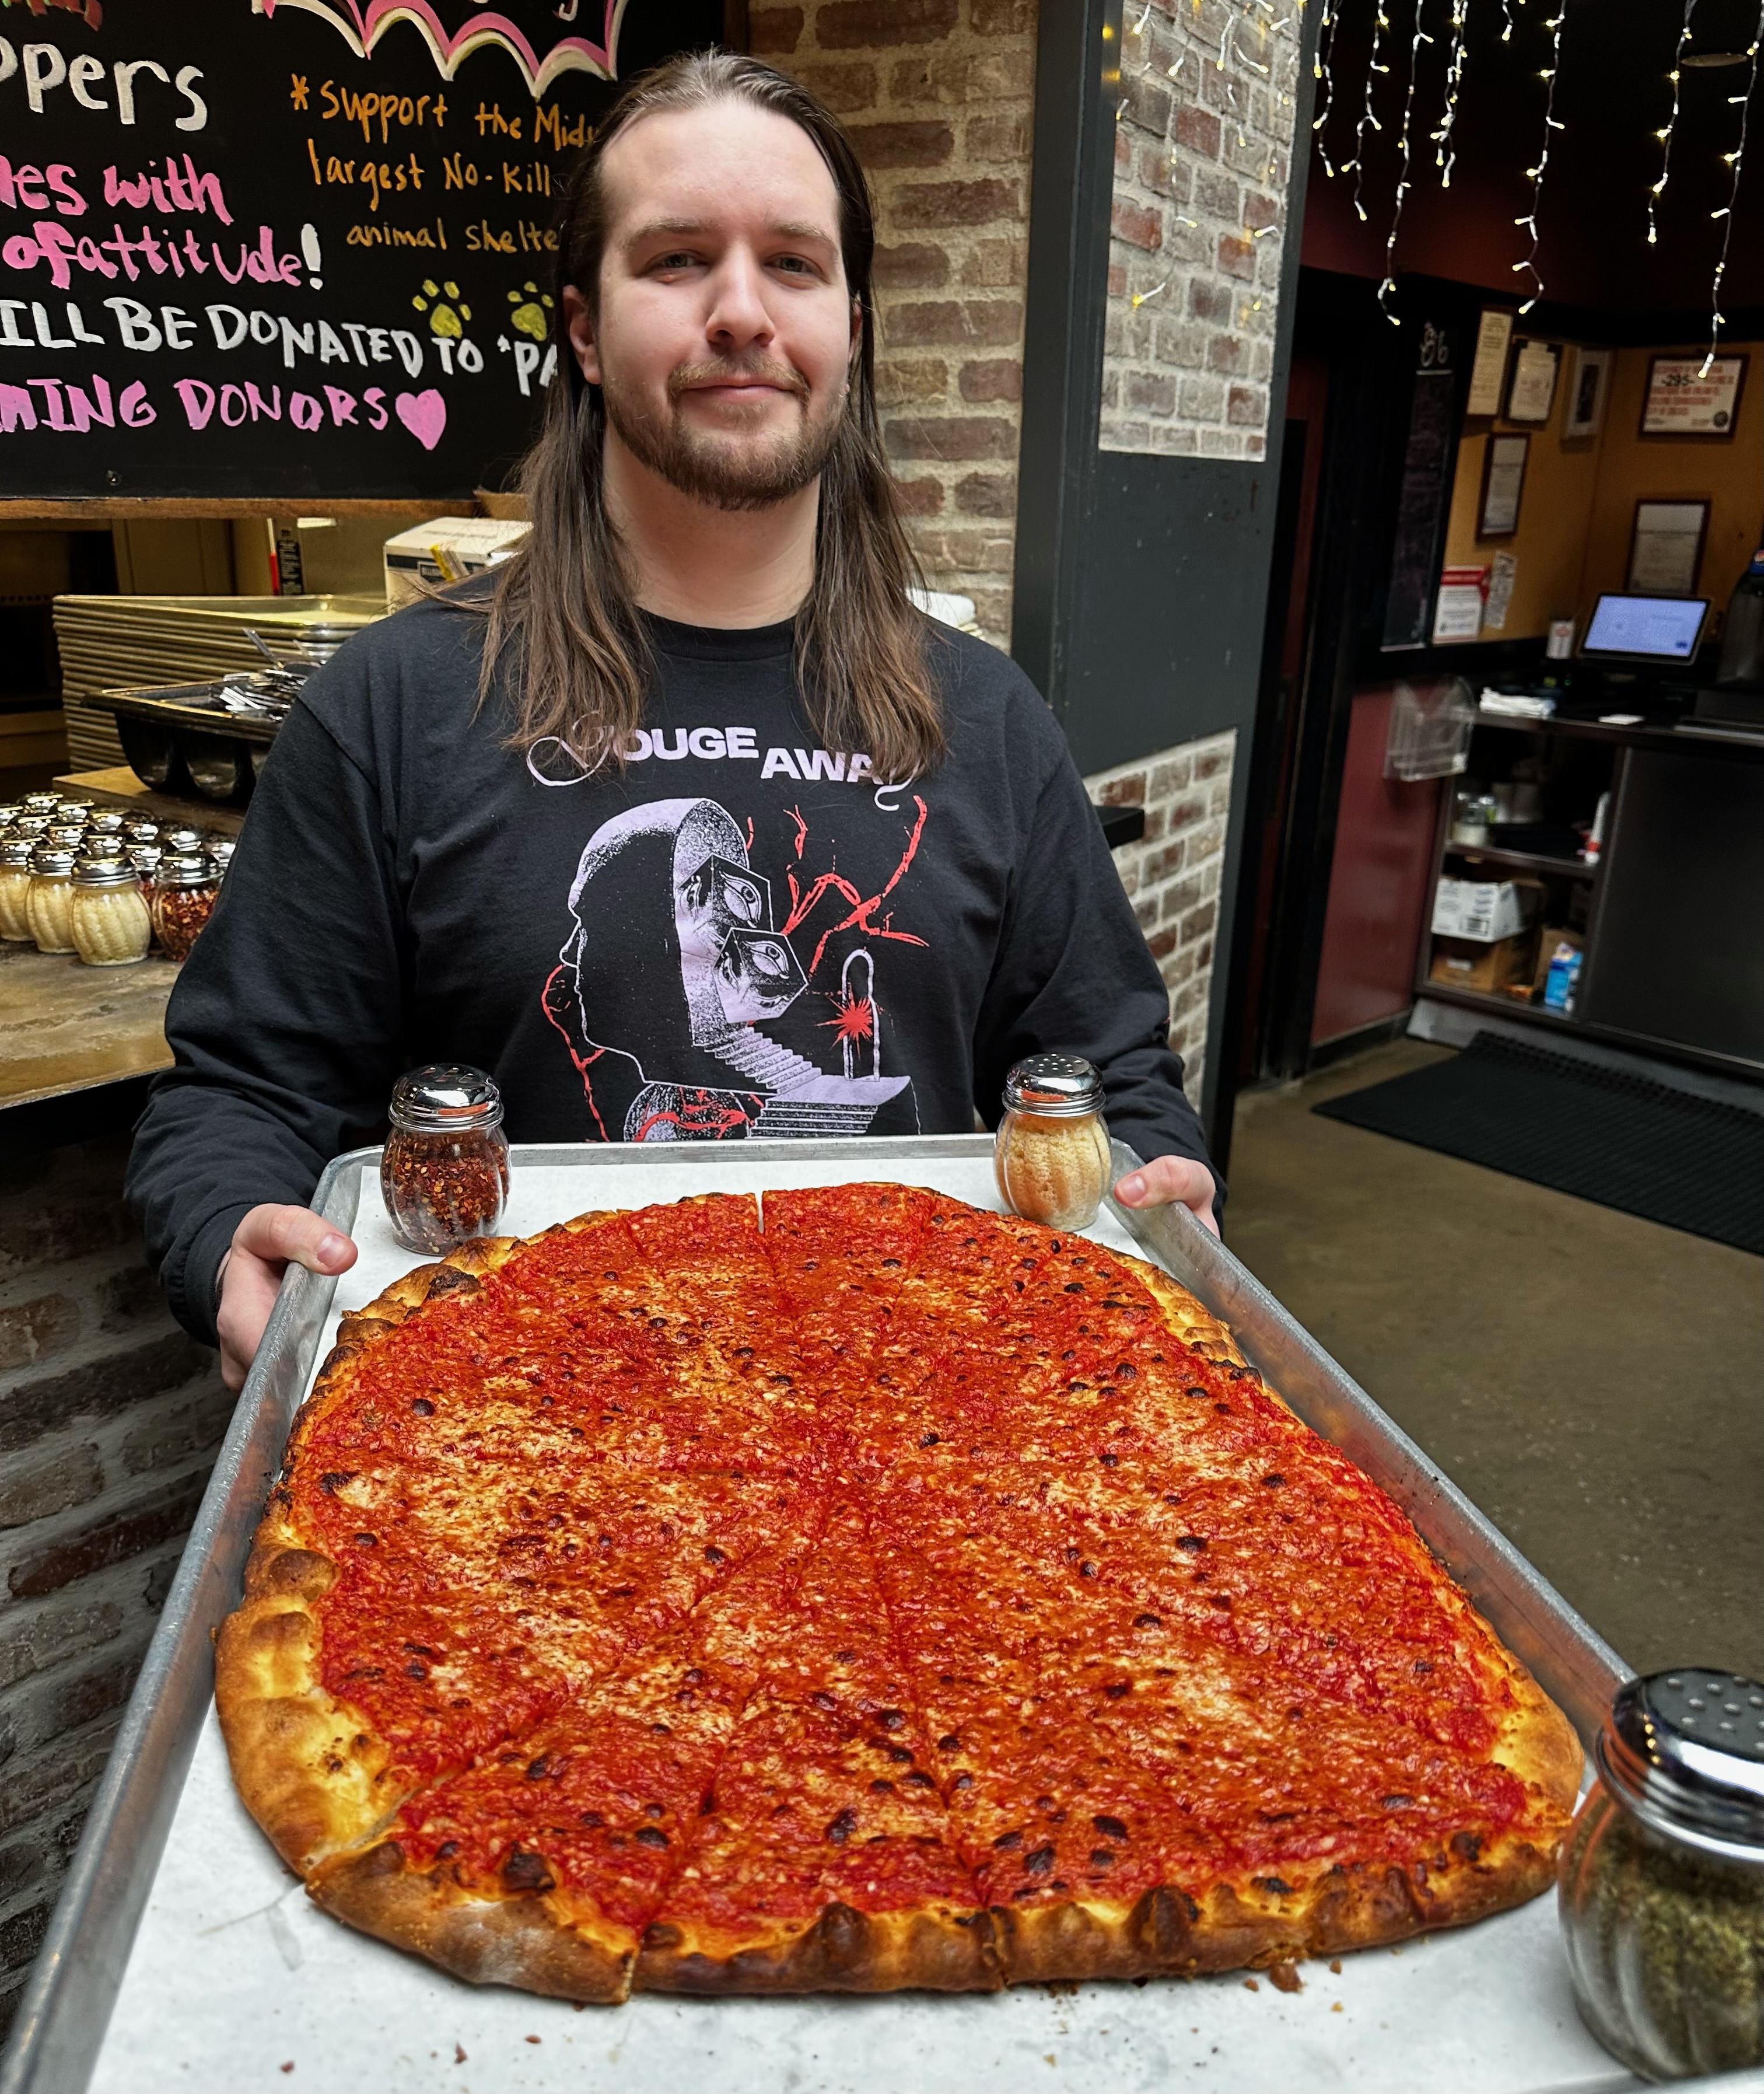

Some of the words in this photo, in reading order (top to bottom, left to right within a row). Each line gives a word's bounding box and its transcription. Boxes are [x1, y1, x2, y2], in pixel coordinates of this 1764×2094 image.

[474, 102, 522, 139] the
[103, 153, 235, 226] with
[307, 138, 425, 211] largest
[346, 218, 447, 250] animal
[103, 296, 198, 352] BE
[205, 304, 424, 378] DONATED
[431, 337, 484, 375] TO
[173, 379, 388, 432] DONORS
